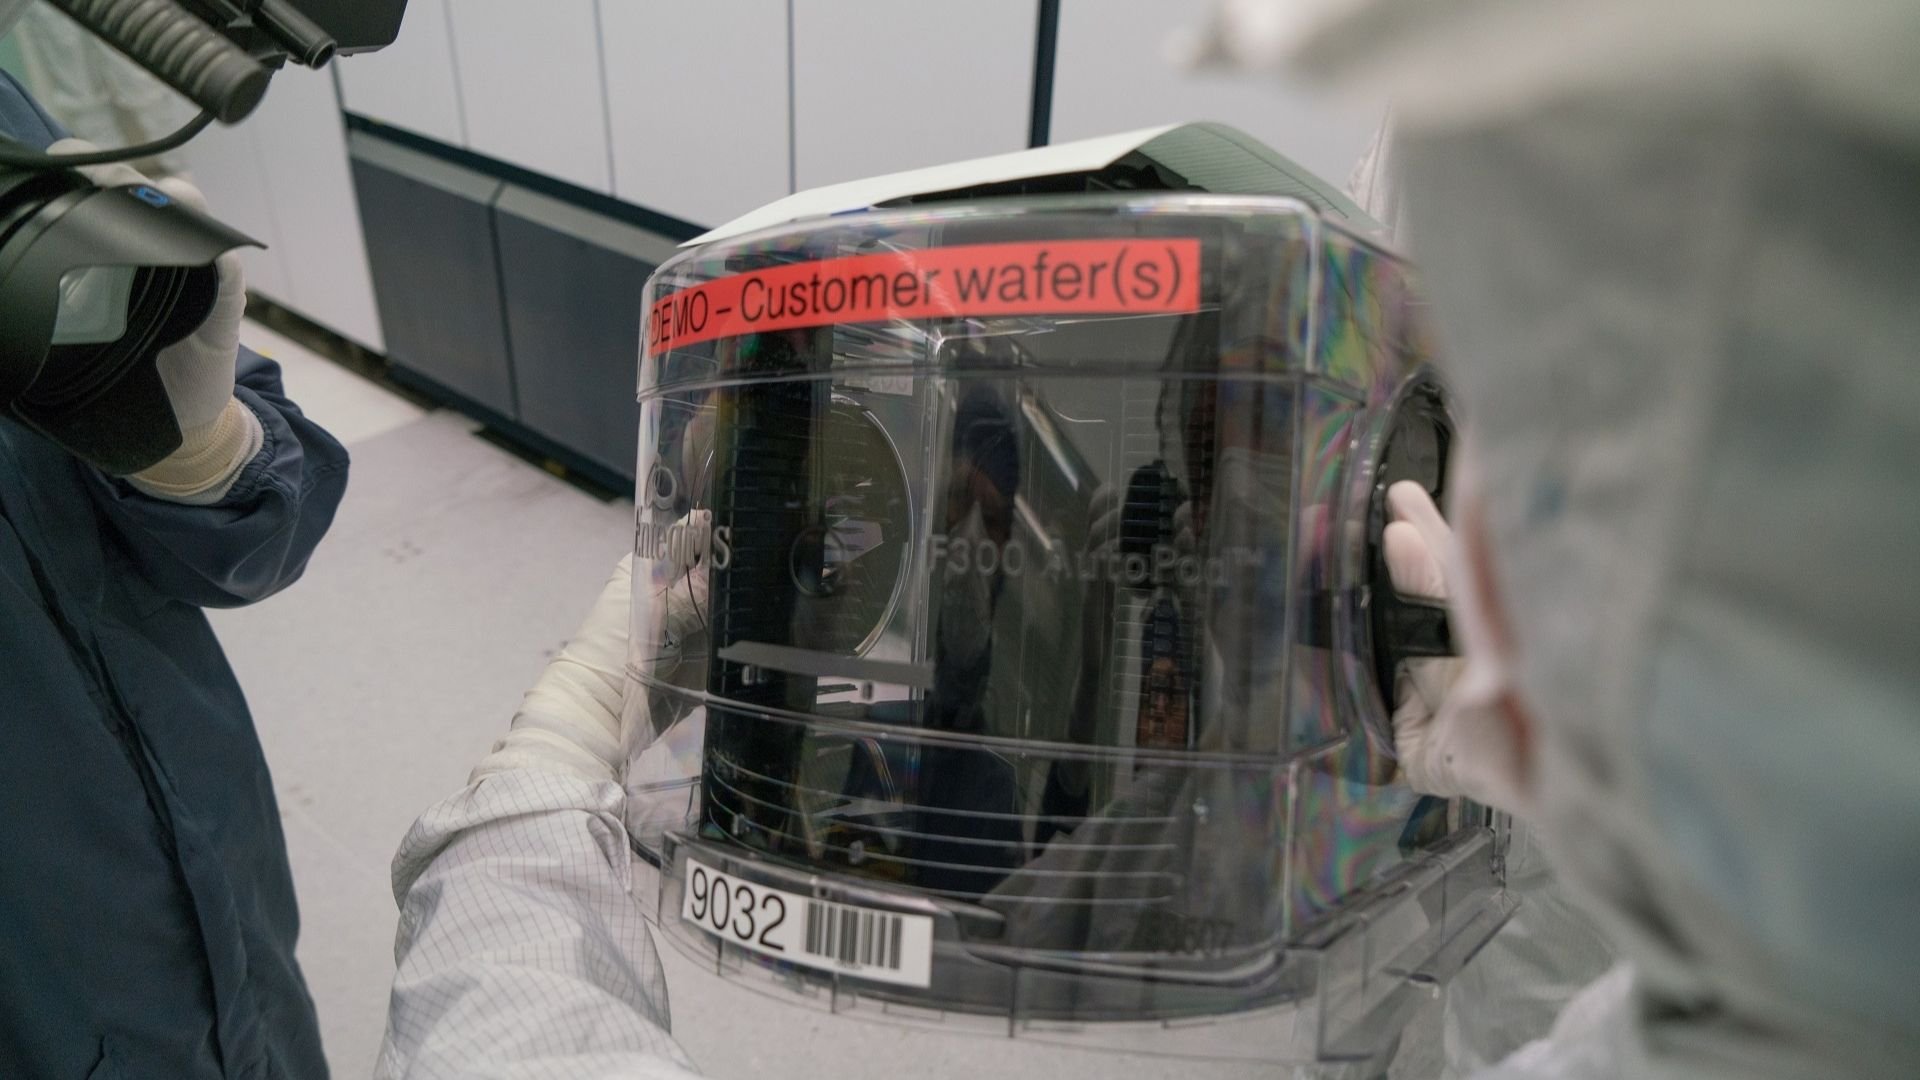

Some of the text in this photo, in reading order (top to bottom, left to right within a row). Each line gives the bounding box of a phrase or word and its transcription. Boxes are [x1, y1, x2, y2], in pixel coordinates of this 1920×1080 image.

[650, 290, 708, 347] DEMO
[741, 269, 941, 322] Customer
[954, 246, 1181, 307] wafer(s)
[928, 534, 1026, 577] F300
[691, 867, 786, 952] 9032
